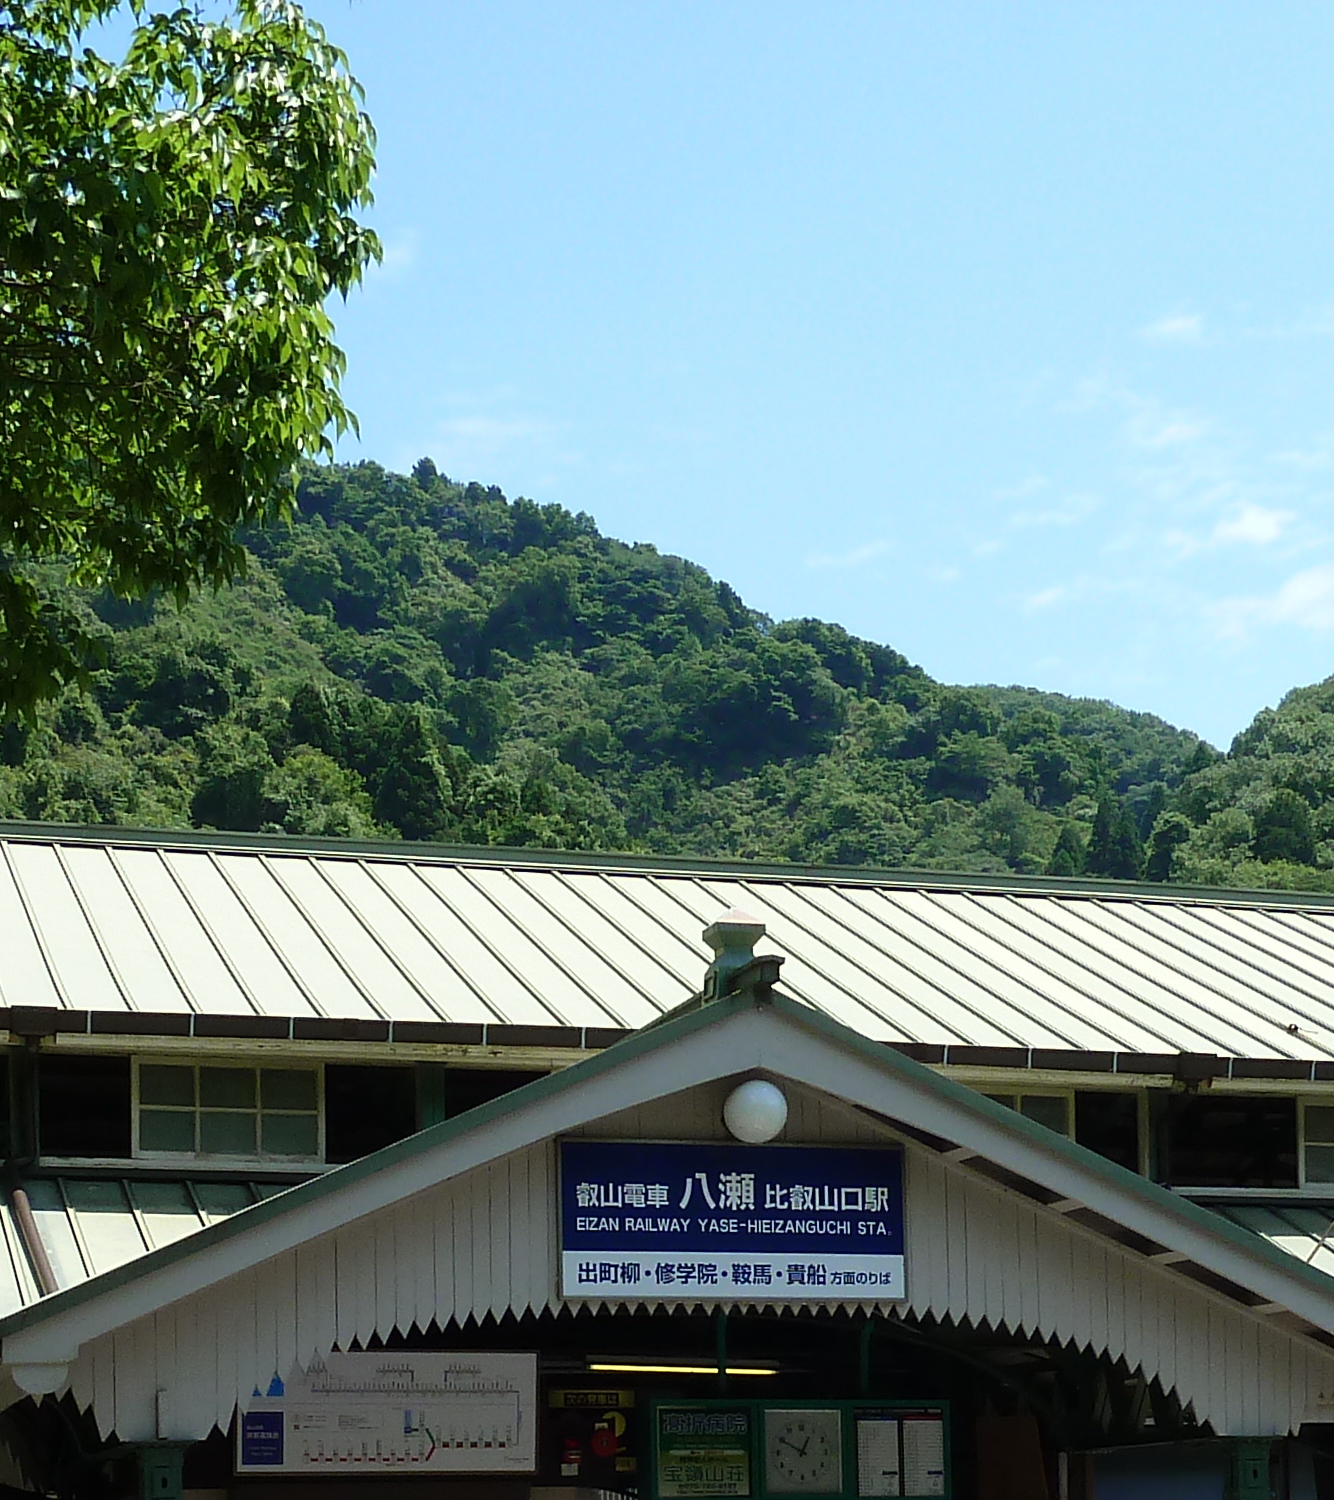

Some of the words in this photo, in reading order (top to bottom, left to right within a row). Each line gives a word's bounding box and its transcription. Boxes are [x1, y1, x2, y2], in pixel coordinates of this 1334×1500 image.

[576, 1182, 670, 1209] 叡山電車
[679, 1172, 755, 1211] 八瀬
[764, 1184, 889, 1212] 比叡山口駅
[576, 1217, 619, 1231] EIZAN
[625, 1218, 691, 1233] RAILWAY
[698, 1219, 851, 1235] YASE-HIEIZANGUCHI
